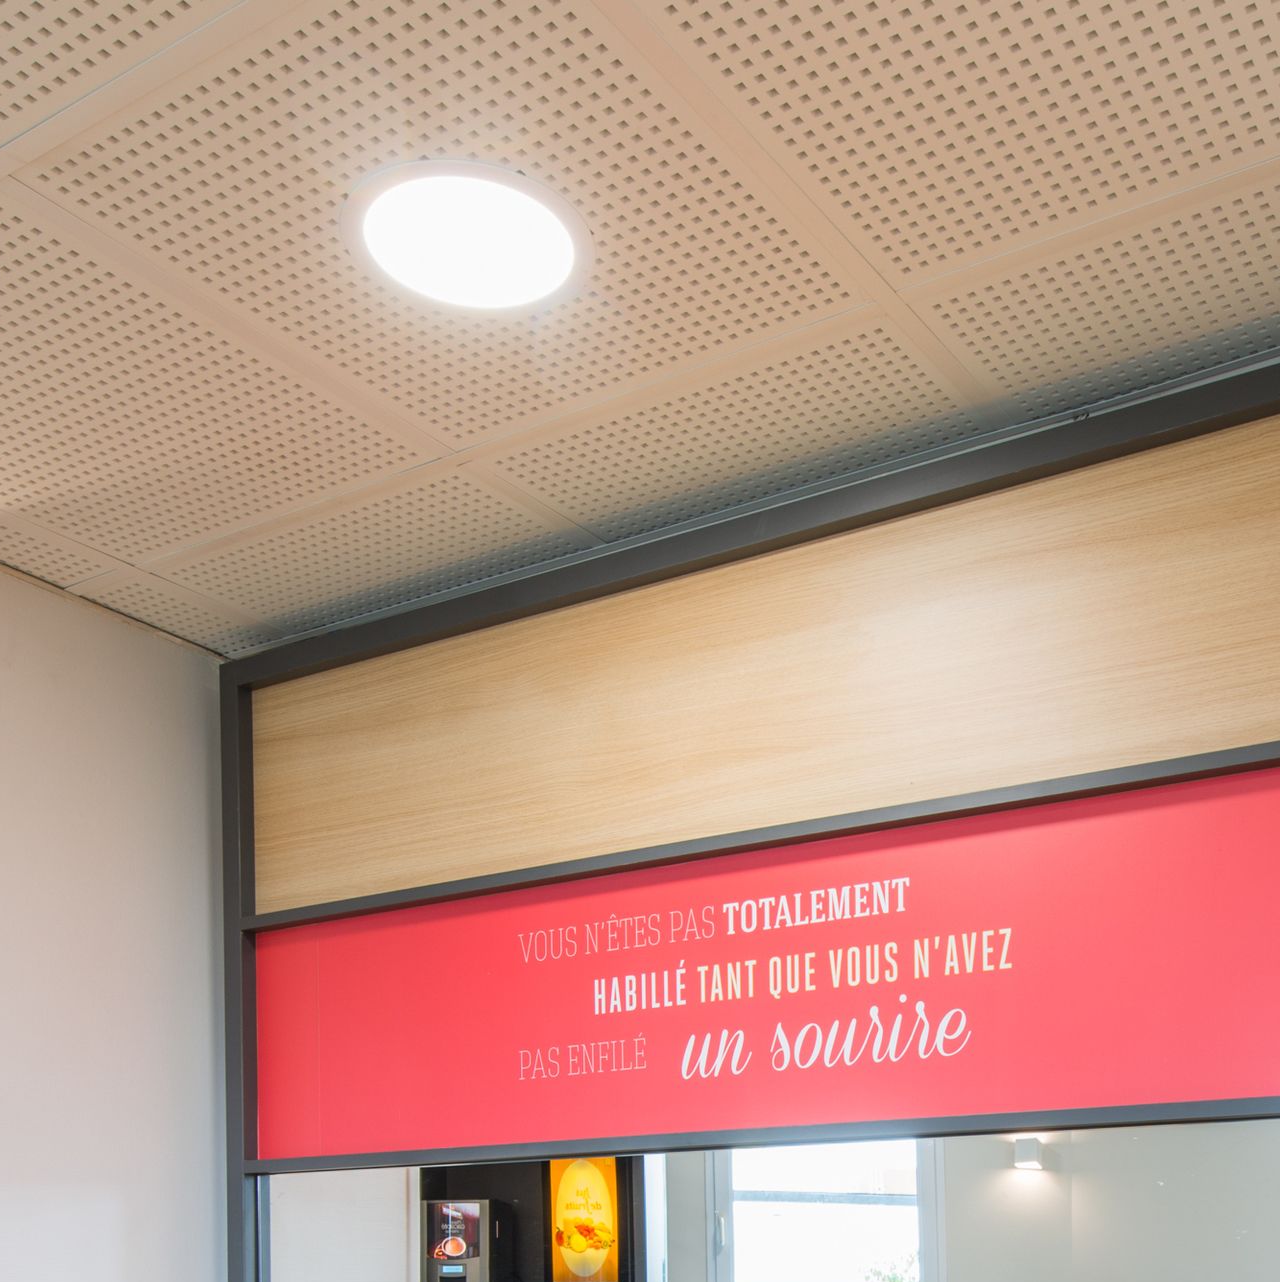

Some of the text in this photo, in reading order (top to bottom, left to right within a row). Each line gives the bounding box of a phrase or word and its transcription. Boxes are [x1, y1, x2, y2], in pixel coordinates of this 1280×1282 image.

[517, 876, 910, 964] VOUS N'ÊTES PAS TOTALEMENT
[593, 927, 1013, 1016] HABILLÉ TANT QUE VOUS N'AVEZ
[518, 993, 972, 1081] PAS ENFILÉ un sourire
